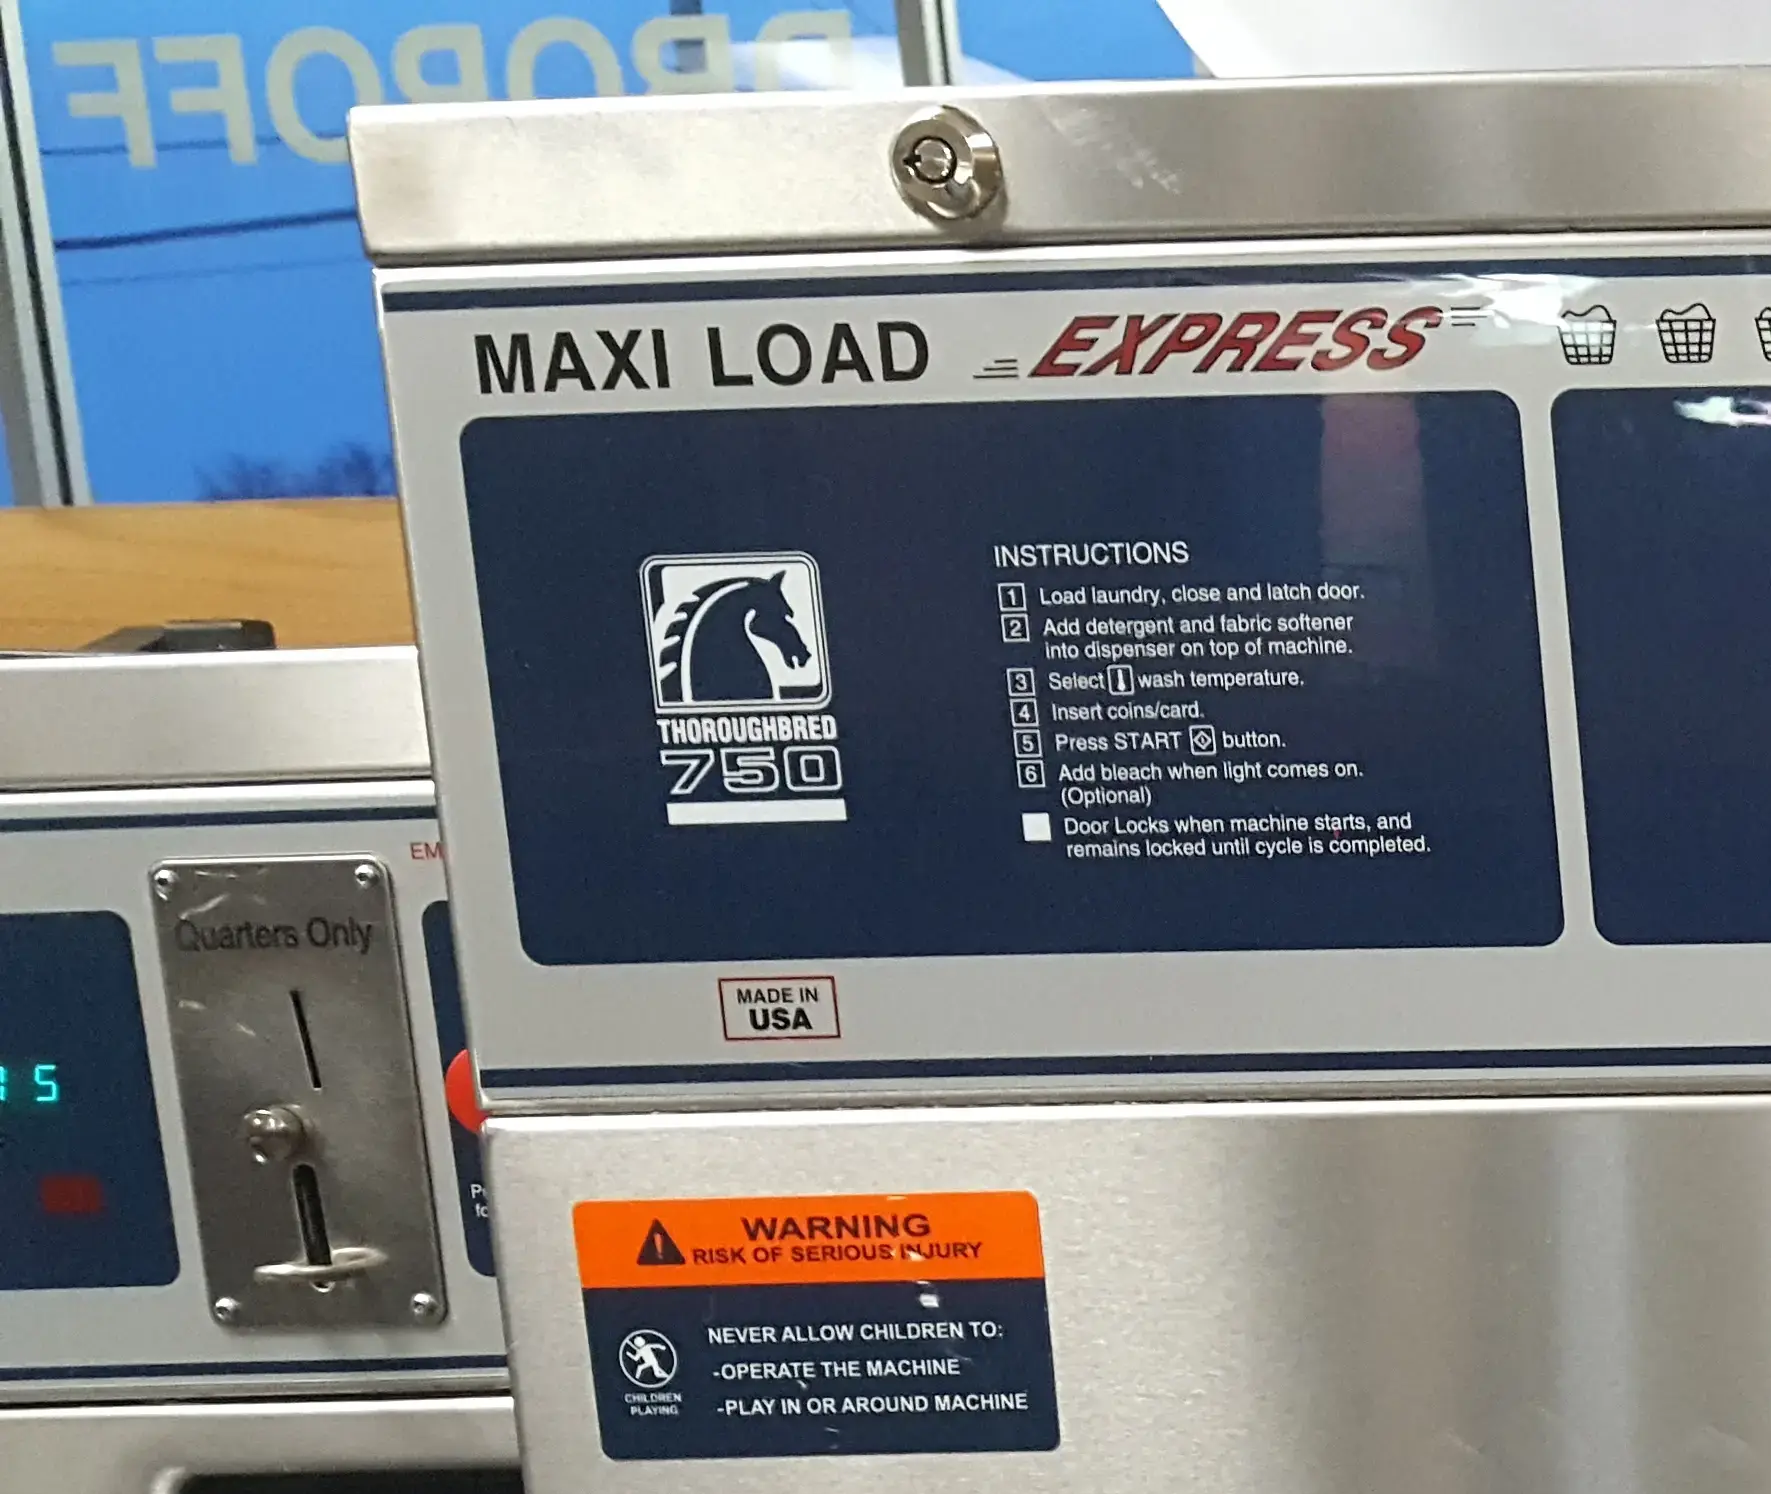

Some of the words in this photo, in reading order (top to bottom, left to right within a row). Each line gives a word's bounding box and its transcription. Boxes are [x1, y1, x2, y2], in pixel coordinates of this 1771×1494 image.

[475, 329, 670, 394] MAXI
[707, 322, 928, 386] LOAD
[1028, 306, 1443, 378] EXPRESS
[994, 541, 1189, 567] INSTRUCTIONS
[1040, 587, 1086, 605] Load
[1092, 585, 1165, 607] laundry,
[1172, 585, 1220, 602] close
[1227, 583, 1261, 601] and
[1267, 583, 1311, 600] latch
[1318, 582, 1364, 599] door.
[1044, 618, 1080, 636] Add
[1086, 617, 1174, 639] detergent
[1180, 615, 1214, 633] and
[1220, 614, 1271, 632] fabric
[1278, 613, 1353, 631] softener
[1045, 642, 1079, 659] into
[1085, 641, 1175, 662] dispenser
[1181, 642, 1204, 656] on
[1209, 639, 1239, 660] top
[1245, 637, 1262, 655] of
[1268, 636, 1352, 654] machine.
[1049, 672, 1105, 690] Select
[1138, 670, 1185, 688] wash
[1190, 669, 1304, 691] temperature.
[1052, 703, 1103, 721] Insert
[1107, 701, 1204, 720] coins/card.
[657, 715, 837, 744] THOROUGHBRED
[1056, 734, 1108, 751] Press
[1114, 731, 1182, 750] START
[1222, 731, 1285, 748] button.
[660, 745, 843, 796] 750
[1059, 764, 1095, 781] Add
[1101, 763, 1162, 781] bleach
[1167, 762, 1217, 779] when
[1223, 761, 1262, 783] light
[1267, 763, 1328, 778] comes
[1335, 763, 1363, 777] on.
[1062, 786, 1151, 808] (Optional)
[1064, 818, 1109, 835] Door
[1115, 816, 1169, 834] Locks
[1174, 816, 1224, 833] when
[1230, 814, 1308, 832] machine
[1315, 814, 1371, 832] starts,
[1377, 812, 1411, 829] and
[1067, 840, 1140, 857] remains
[1146, 838, 1206, 856] locked
[1212, 837, 1249, 855] until
[1255, 837, 1302, 858] cycle
[1308, 836, 1323, 853] is
[1329, 835, 1430, 857] completed.
[175, 920, 299, 952] Quarters
[308, 917, 372, 954] Only
[737, 988, 793, 1004] MADE
[800, 988, 818, 1002] IN
[749, 1007, 812, 1031] USA
[742, 1214, 930, 1241] WARNING
[693, 1248, 746, 1265] RISK
[753, 1247, 783, 1263] OF
[792, 1244, 892, 1262] SERIOUS
[900, 1241, 983, 1260] INJURY
[708, 1327, 777, 1343] NEVER
[782, 1325, 853, 1342] ALLOW
[860, 1322, 964, 1340] CHILDREN
[969, 1321, 1002, 1337] TO:
[820, 1361, 861, 1377] THE
[867, 1359, 960, 1376] MACHINE
[781, 1399, 801, 1414] IN
[807, 1398, 837, 1414] OR
[842, 1396, 928, 1413] AROUND
[935, 1393, 1028, 1411] MACHINE
